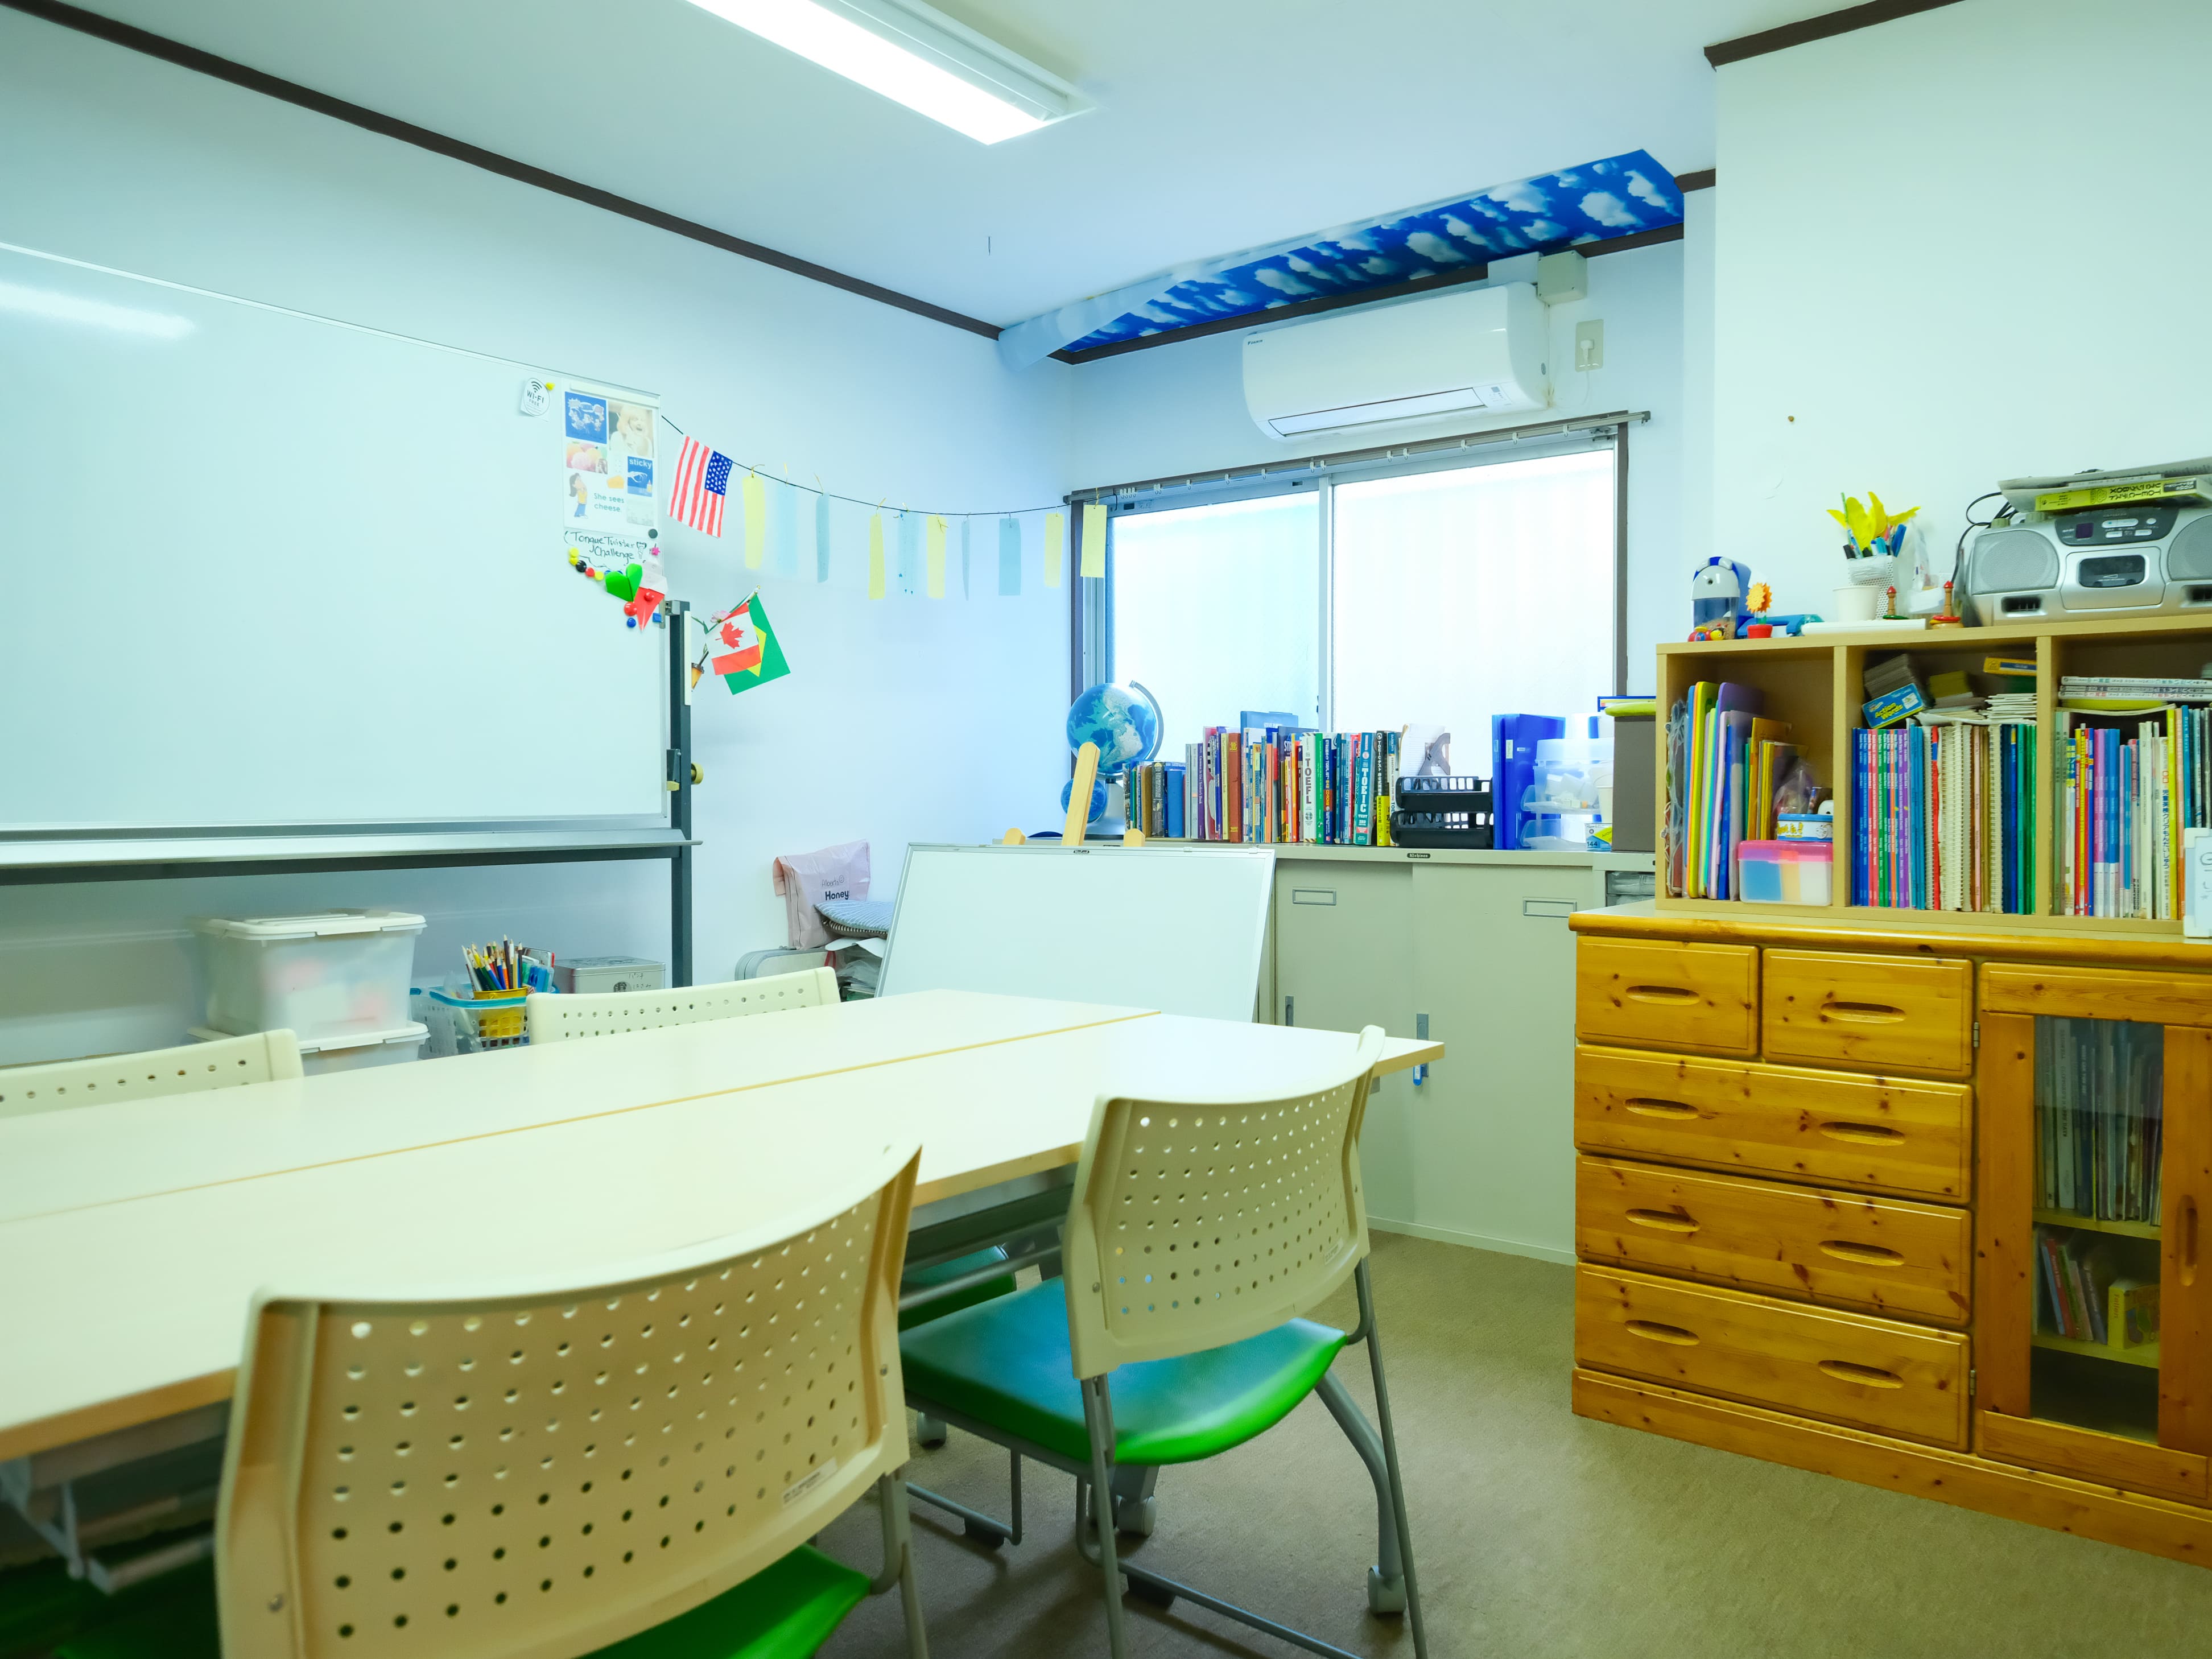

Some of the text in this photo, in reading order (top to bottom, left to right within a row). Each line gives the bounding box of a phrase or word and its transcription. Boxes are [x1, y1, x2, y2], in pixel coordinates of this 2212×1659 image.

[527, 389, 544, 403] WI-FI
[629, 457, 653, 469] sticky
[594, 493, 625, 504] She sees
[570, 531, 605, 553] Tongue
[595, 546, 635, 564] Challenge
[1875, 703, 1896, 718] Action
[1881, 705, 1903, 719] Words
[1360, 767, 1369, 812] TOEIC
[822, 877, 839, 888] Alberto
[825, 891, 849, 901] Honey
